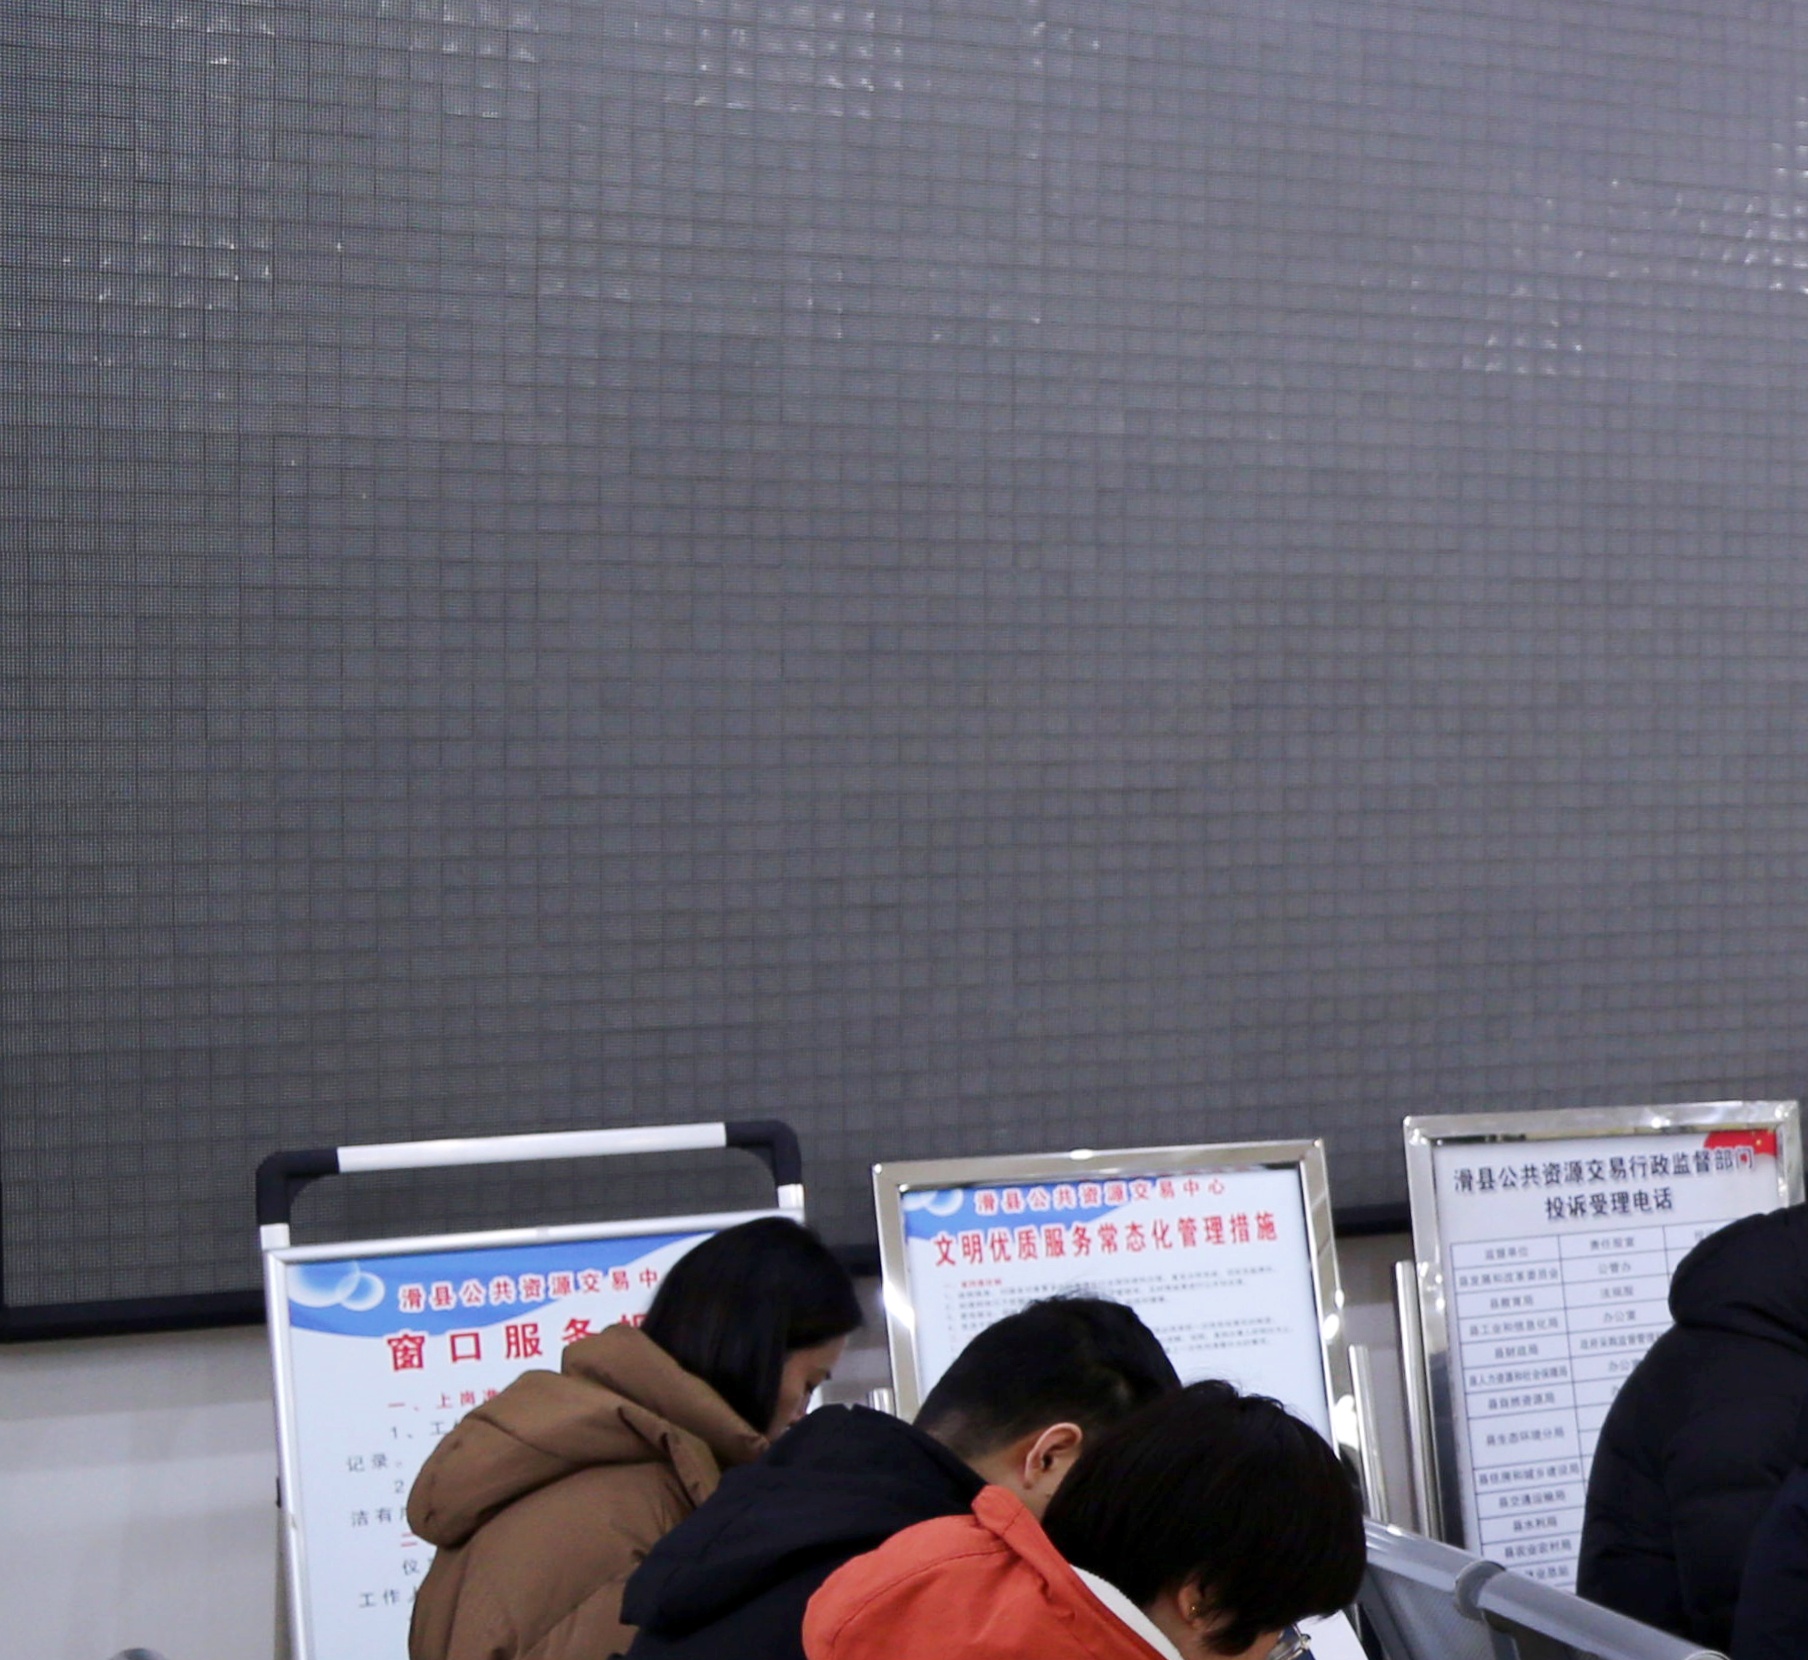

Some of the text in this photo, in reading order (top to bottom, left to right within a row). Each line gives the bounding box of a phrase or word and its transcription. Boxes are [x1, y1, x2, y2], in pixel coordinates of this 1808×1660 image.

[1453, 1146, 1757, 1194] 滑县公共资源交易行政监督部门
[974, 1177, 1227, 1215] 滑县公共资源交易中心
[1545, 1187, 1674, 1222] 投诉受理电话
[934, 1210, 1279, 1267] 文明优质服务常态化管理措施
